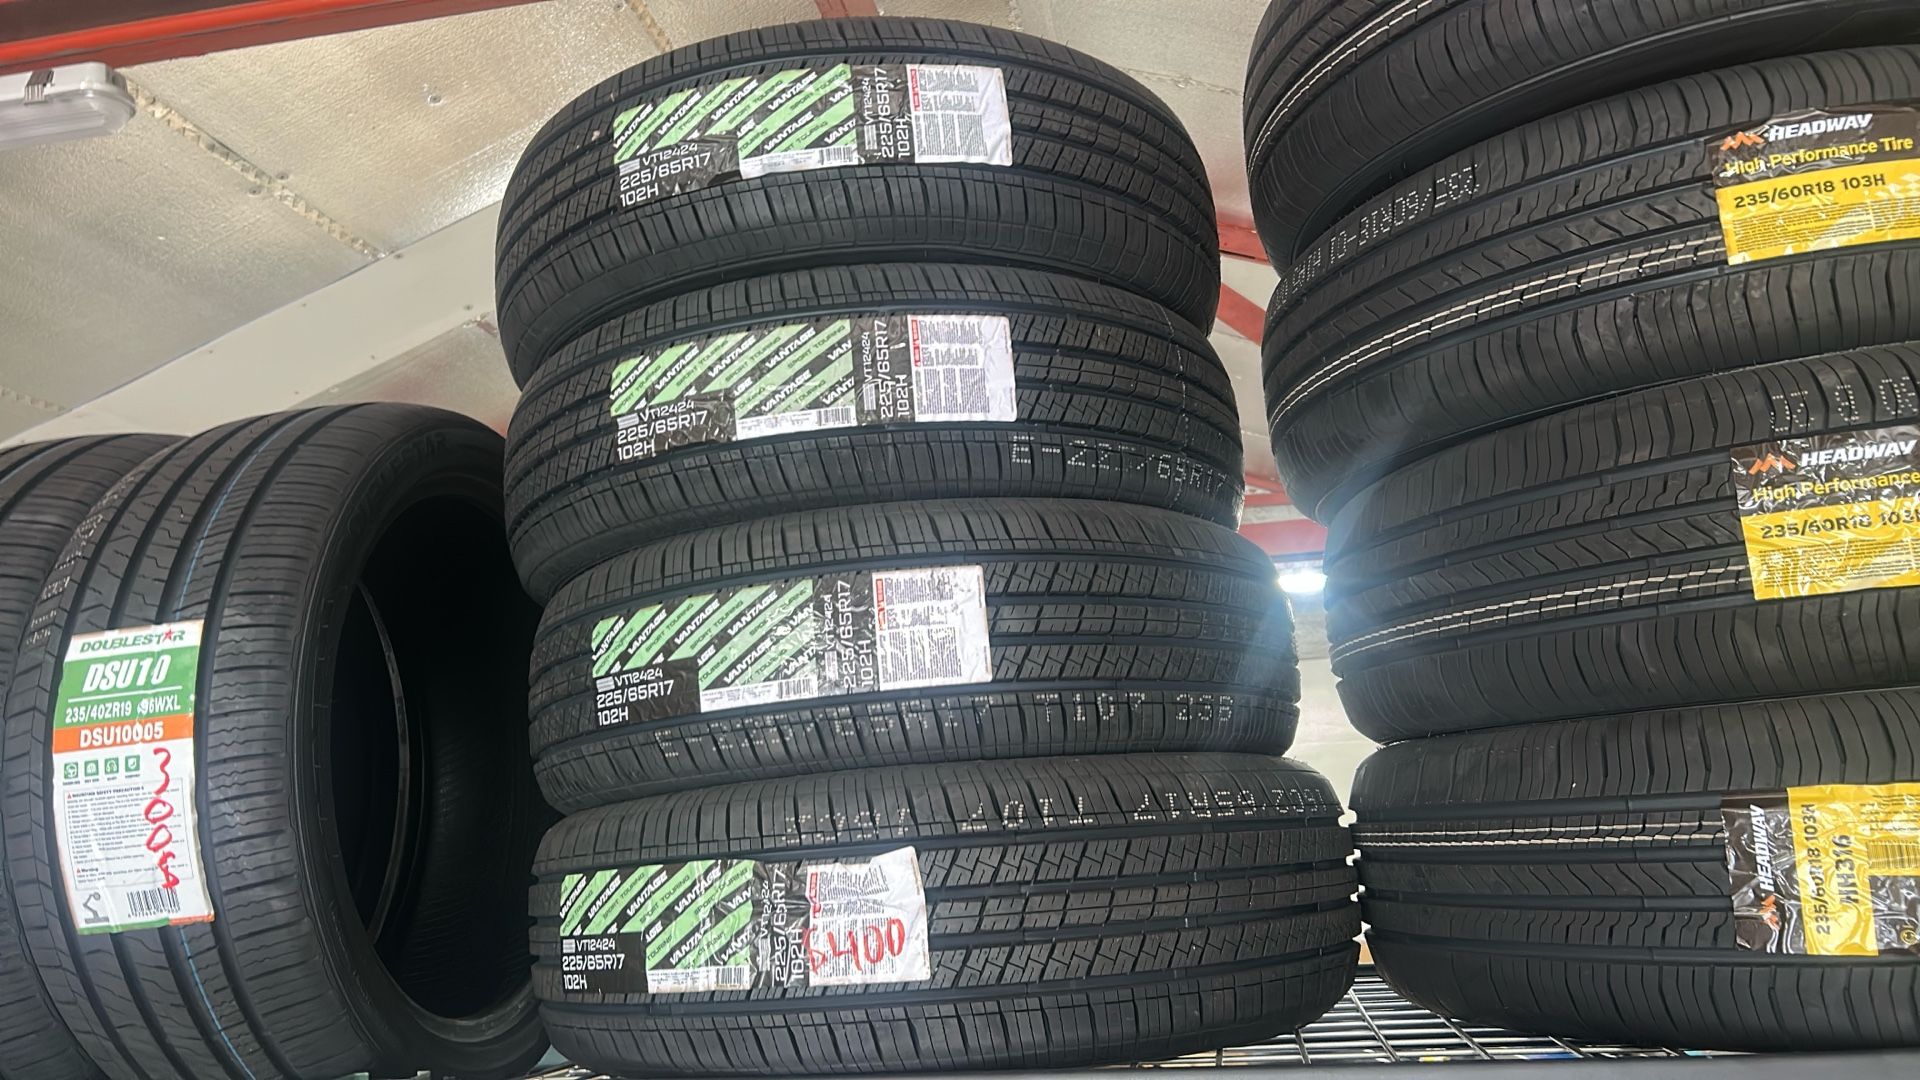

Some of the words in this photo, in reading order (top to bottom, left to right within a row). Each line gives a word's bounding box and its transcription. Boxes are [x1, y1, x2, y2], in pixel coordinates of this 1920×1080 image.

[711, 79, 759, 121] VANTAGE
[768, 72, 817, 110] VANTAGE
[658, 91, 702, 135] VANTAGE
[764, 110, 815, 151] VANTAGE
[875, 68, 895, 158] 225/65R17
[1768, 113, 1873, 143] HEADWAY
[897, 118, 911, 158] 102H
[1725, 158, 1763, 176] High
[1769, 138, 1878, 169] Performance
[1880, 137, 1914, 152] Tire
[620, 152, 711, 192] 225/65R17
[1734, 179, 1836, 209] 235/60R18
[1841, 173, 1886, 191] 103H
[620, 182, 659, 207] 102H
[655, 345, 700, 390] VANTAGE
[708, 334, 757, 378] VANTAGE
[765, 327, 816, 369] VANTAGE
[610, 355, 651, 400] VANTAGE
[761, 369, 812, 412] VANTAGE
[874, 320, 893, 419] 225/65R17
[896, 374, 910, 418] 102H
[617, 410, 708, 444] 225/65R17
[617, 439, 655, 461] 102H
[1800, 439, 1918, 468] HEADWAY
[1753, 485, 1796, 501] High
[1760, 516, 1873, 539] 235/60R18
[627, 608, 667, 654] VANTAGE
[674, 598, 720, 645] VANTAGE
[727, 590, 778, 636] VANTAGE
[592, 616, 626, 661] VANTAGE
[838, 580, 857, 689] 225/65R17
[82, 654, 172, 693] DSU10
[857, 639, 874, 687] 102H
[65, 699, 132, 724] 235/40ZR19
[596, 679, 675, 709] 225/65R17
[79, 720, 164, 749] DSU10005
[597, 706, 629, 726] 102H
[1750, 804, 1775, 892] HEADWAY
[560, 875, 587, 919] VANTAGE
[588, 874, 621, 919] VANTAGE
[626, 870, 668, 917] VANTAGE
[772, 869, 788, 982] 225/65R17
[562, 953, 625, 971] 225/65R17
[790, 928, 804, 981] 102H
[564, 974, 588, 990] 102H
